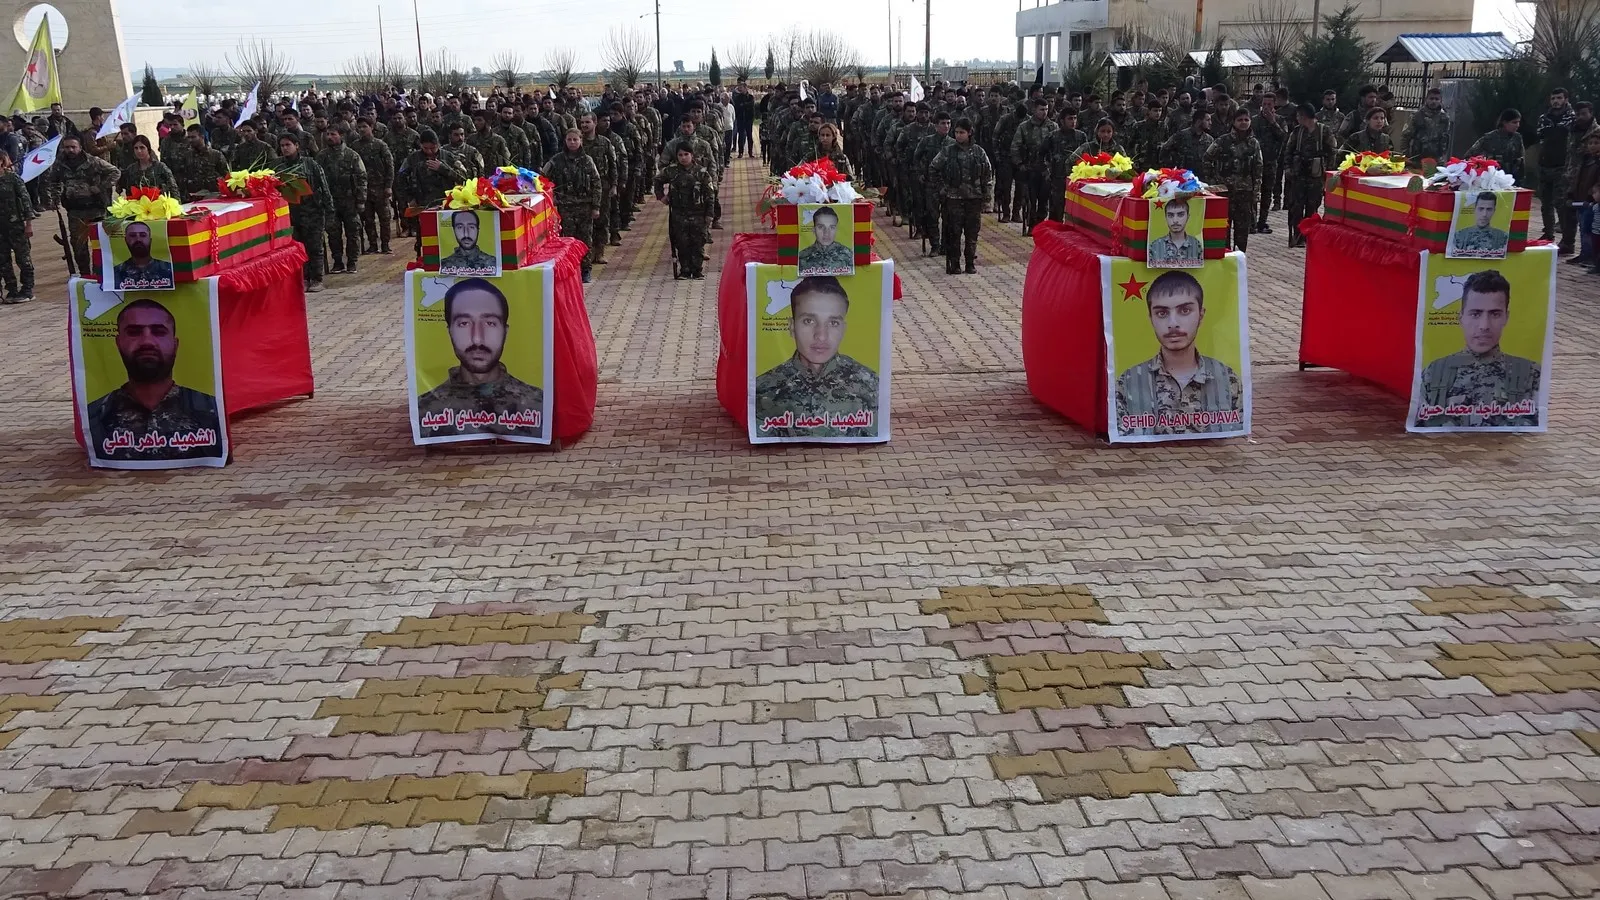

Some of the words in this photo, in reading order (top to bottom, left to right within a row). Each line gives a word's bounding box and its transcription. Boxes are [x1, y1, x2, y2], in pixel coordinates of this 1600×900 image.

[422, 408, 453, 430] العبد
[1158, 412, 1190, 427] ALAN
[1193, 410, 1240, 425] ROJAVA
[1418, 402, 1444, 420] حسين
[1445, 402, 1474, 415] محمد
[1475, 400, 1500, 419] ماجد
[1501, 399, 1535, 419] الشهيد
[498, 409, 540, 430] الشهيد
[760, 409, 793, 431] العمر
[831, 409, 873, 430] الشهيد
[103, 430, 134, 454] العلي
[135, 430, 166, 452] ماهر
[169, 428, 216, 450] الشهيد
